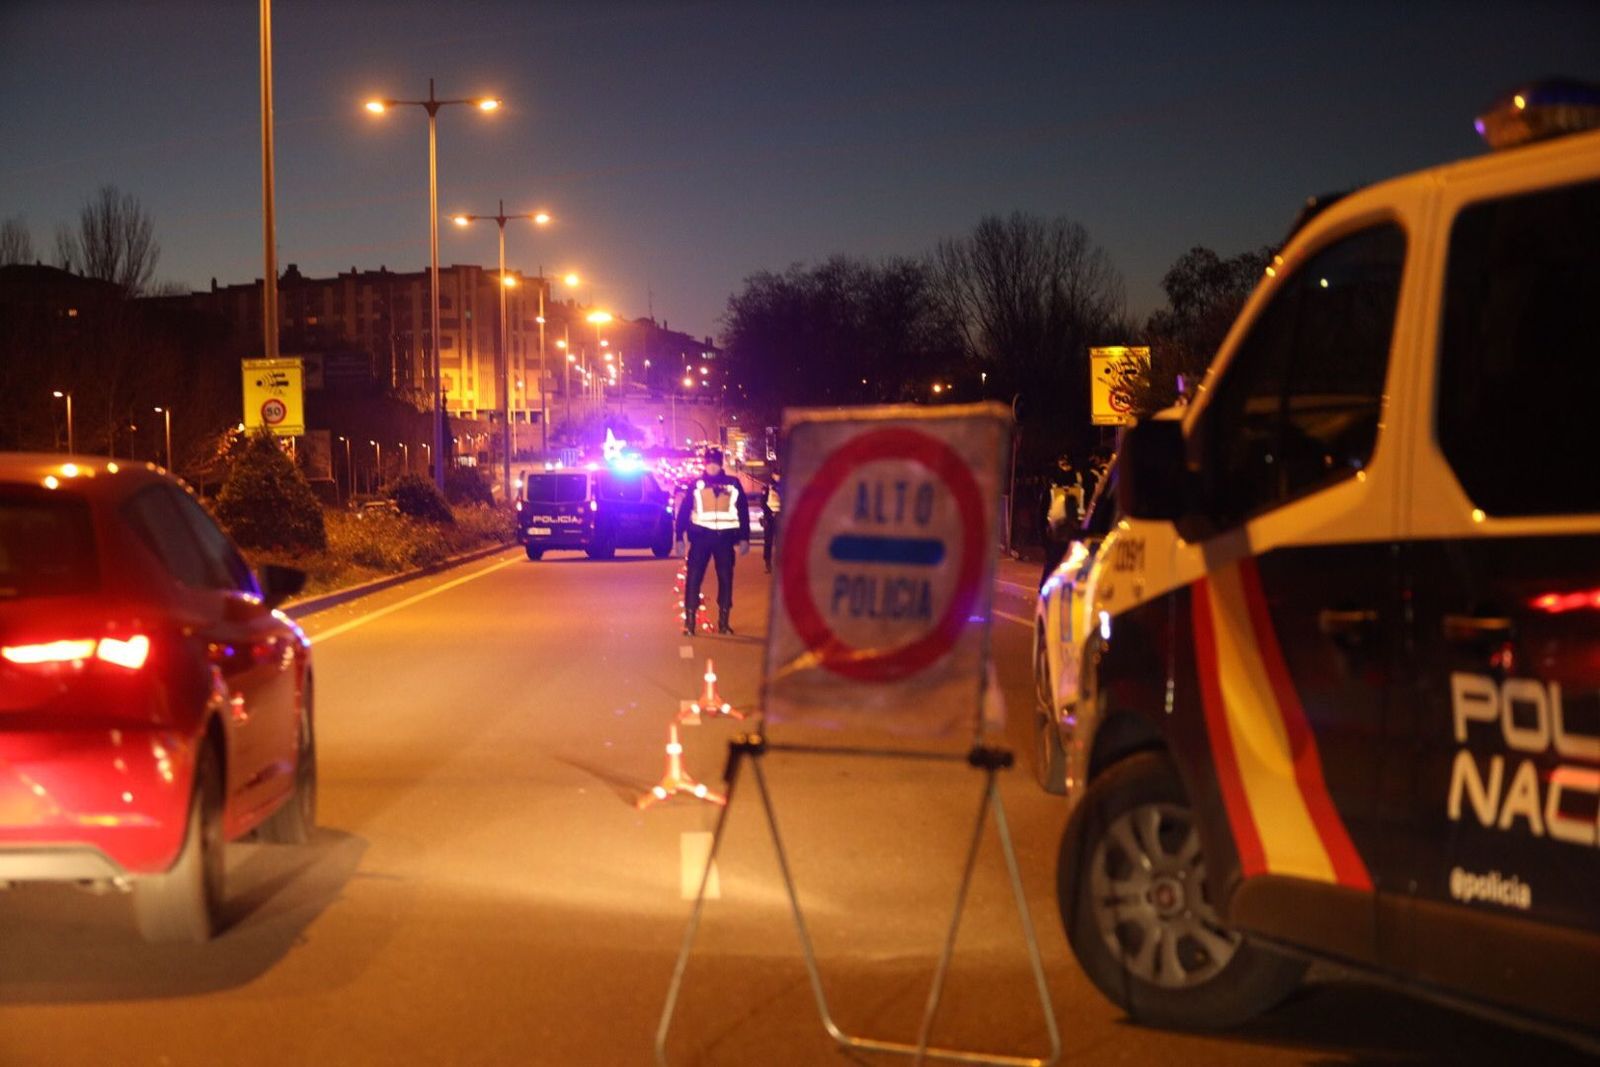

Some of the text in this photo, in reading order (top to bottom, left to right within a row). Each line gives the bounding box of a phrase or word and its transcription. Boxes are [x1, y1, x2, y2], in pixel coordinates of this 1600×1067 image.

[266, 406, 281, 417] 50
[532, 515, 578, 524] POLICIA
[854, 481, 934, 526] ALTO
[831, 575, 932, 620] POLICIA
[1448, 750, 1600, 847] NAC
[1449, 867, 1531, 908] @policia
